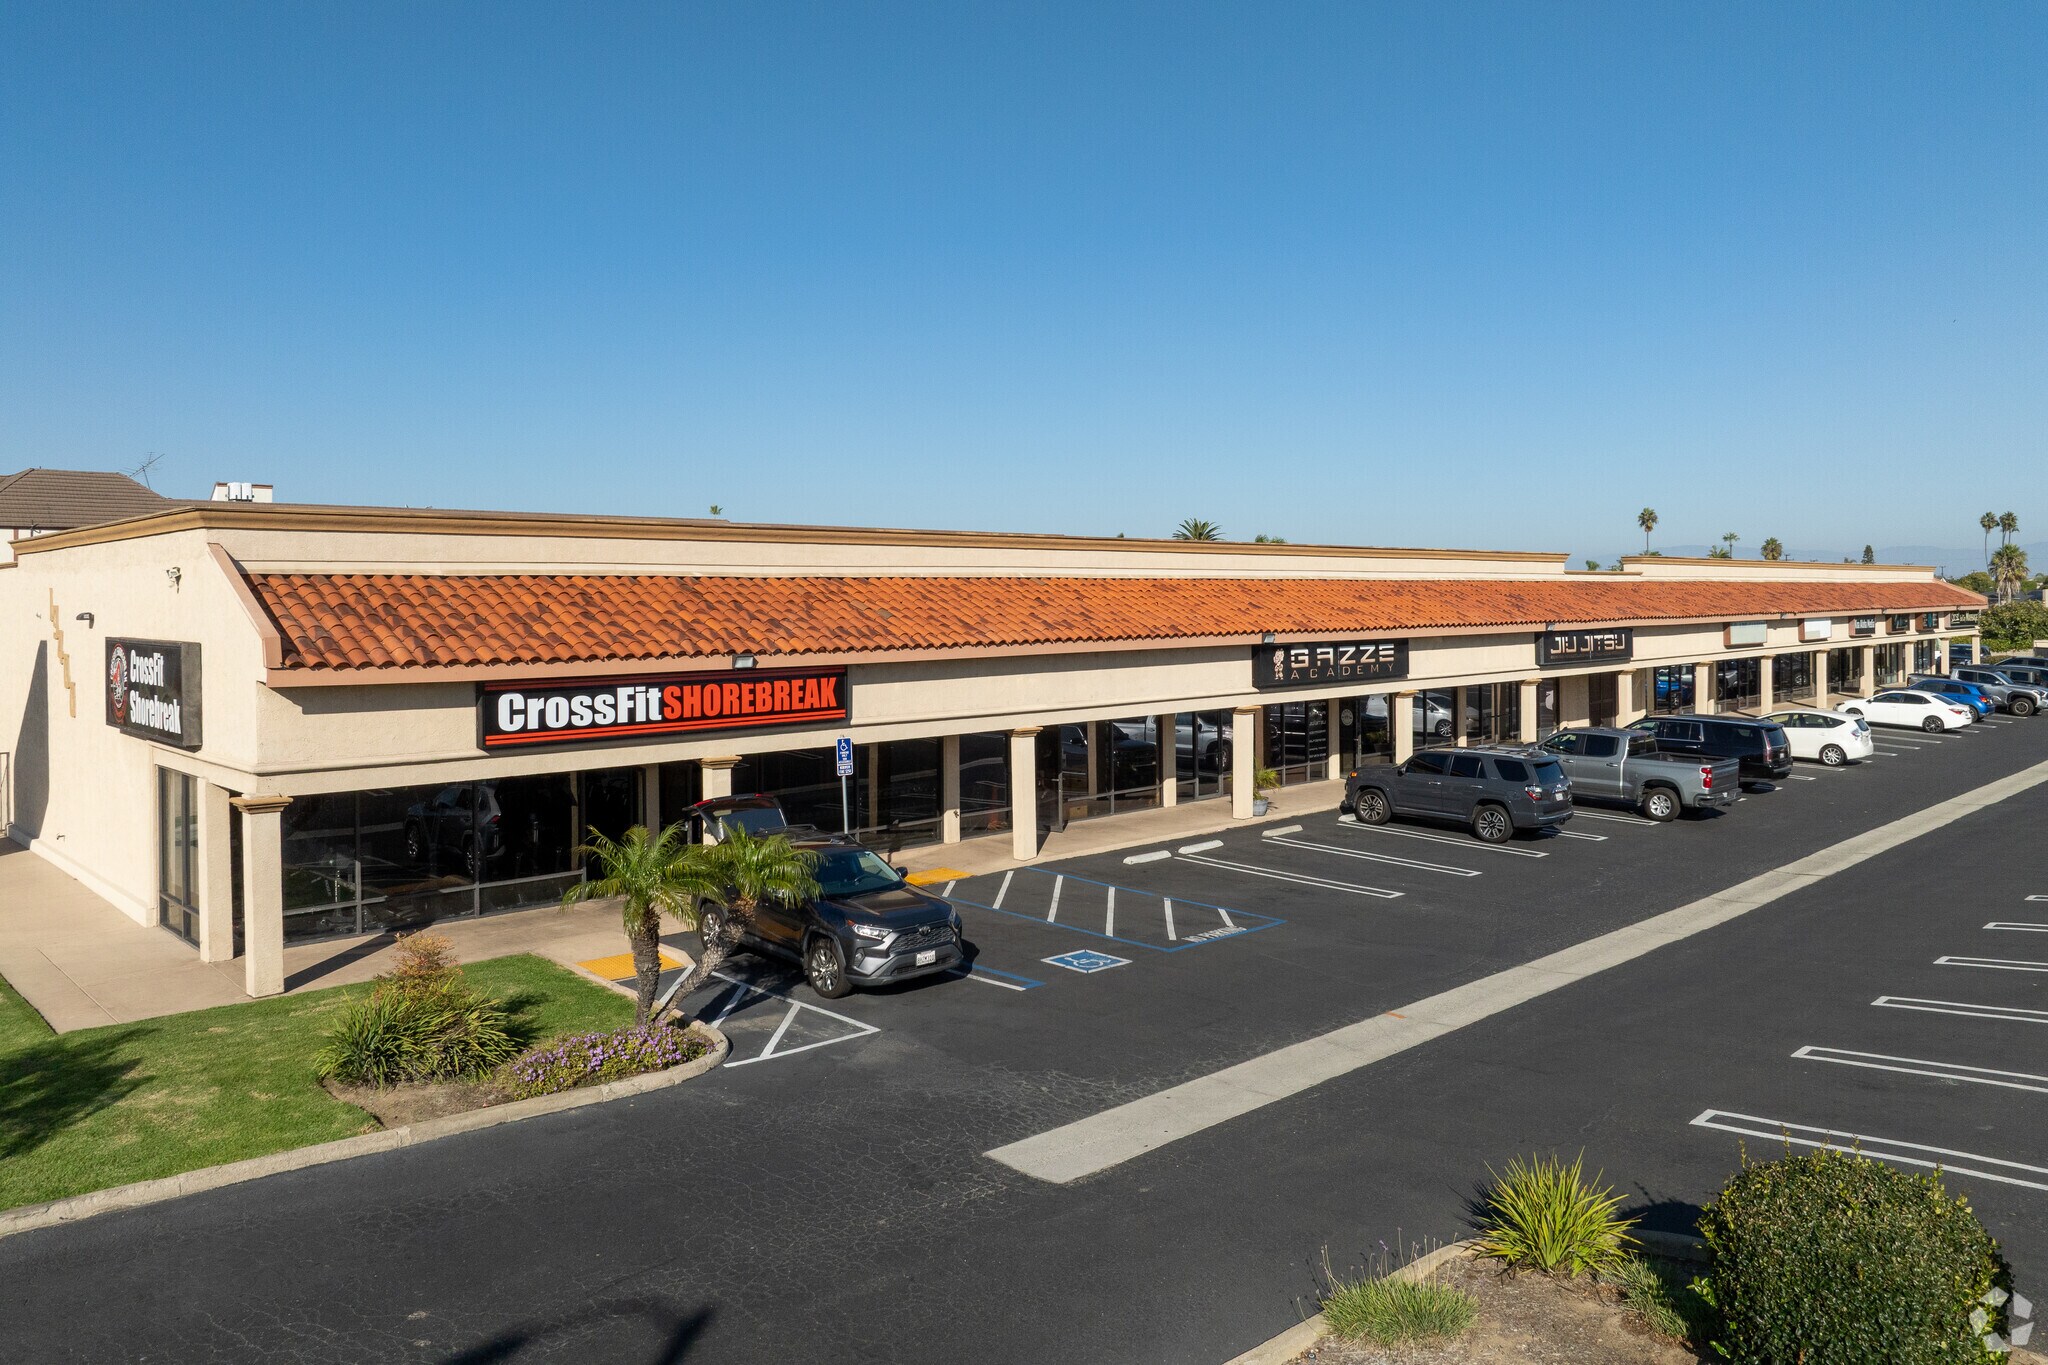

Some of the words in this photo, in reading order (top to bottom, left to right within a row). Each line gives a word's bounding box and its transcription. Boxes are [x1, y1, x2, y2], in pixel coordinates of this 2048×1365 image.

[1290, 643, 1395, 669] GAZZE
[1550, 636, 1577, 654] JIU
[1580, 633, 1625, 652] JITSU
[130, 649, 164, 687] CrossFit
[1290, 663, 1395, 680] ACADEMY
[130, 690, 181, 734] Shorebreak
[497, 686, 662, 731] CrossFit
[663, 677, 837, 720] SHOREBREAK
